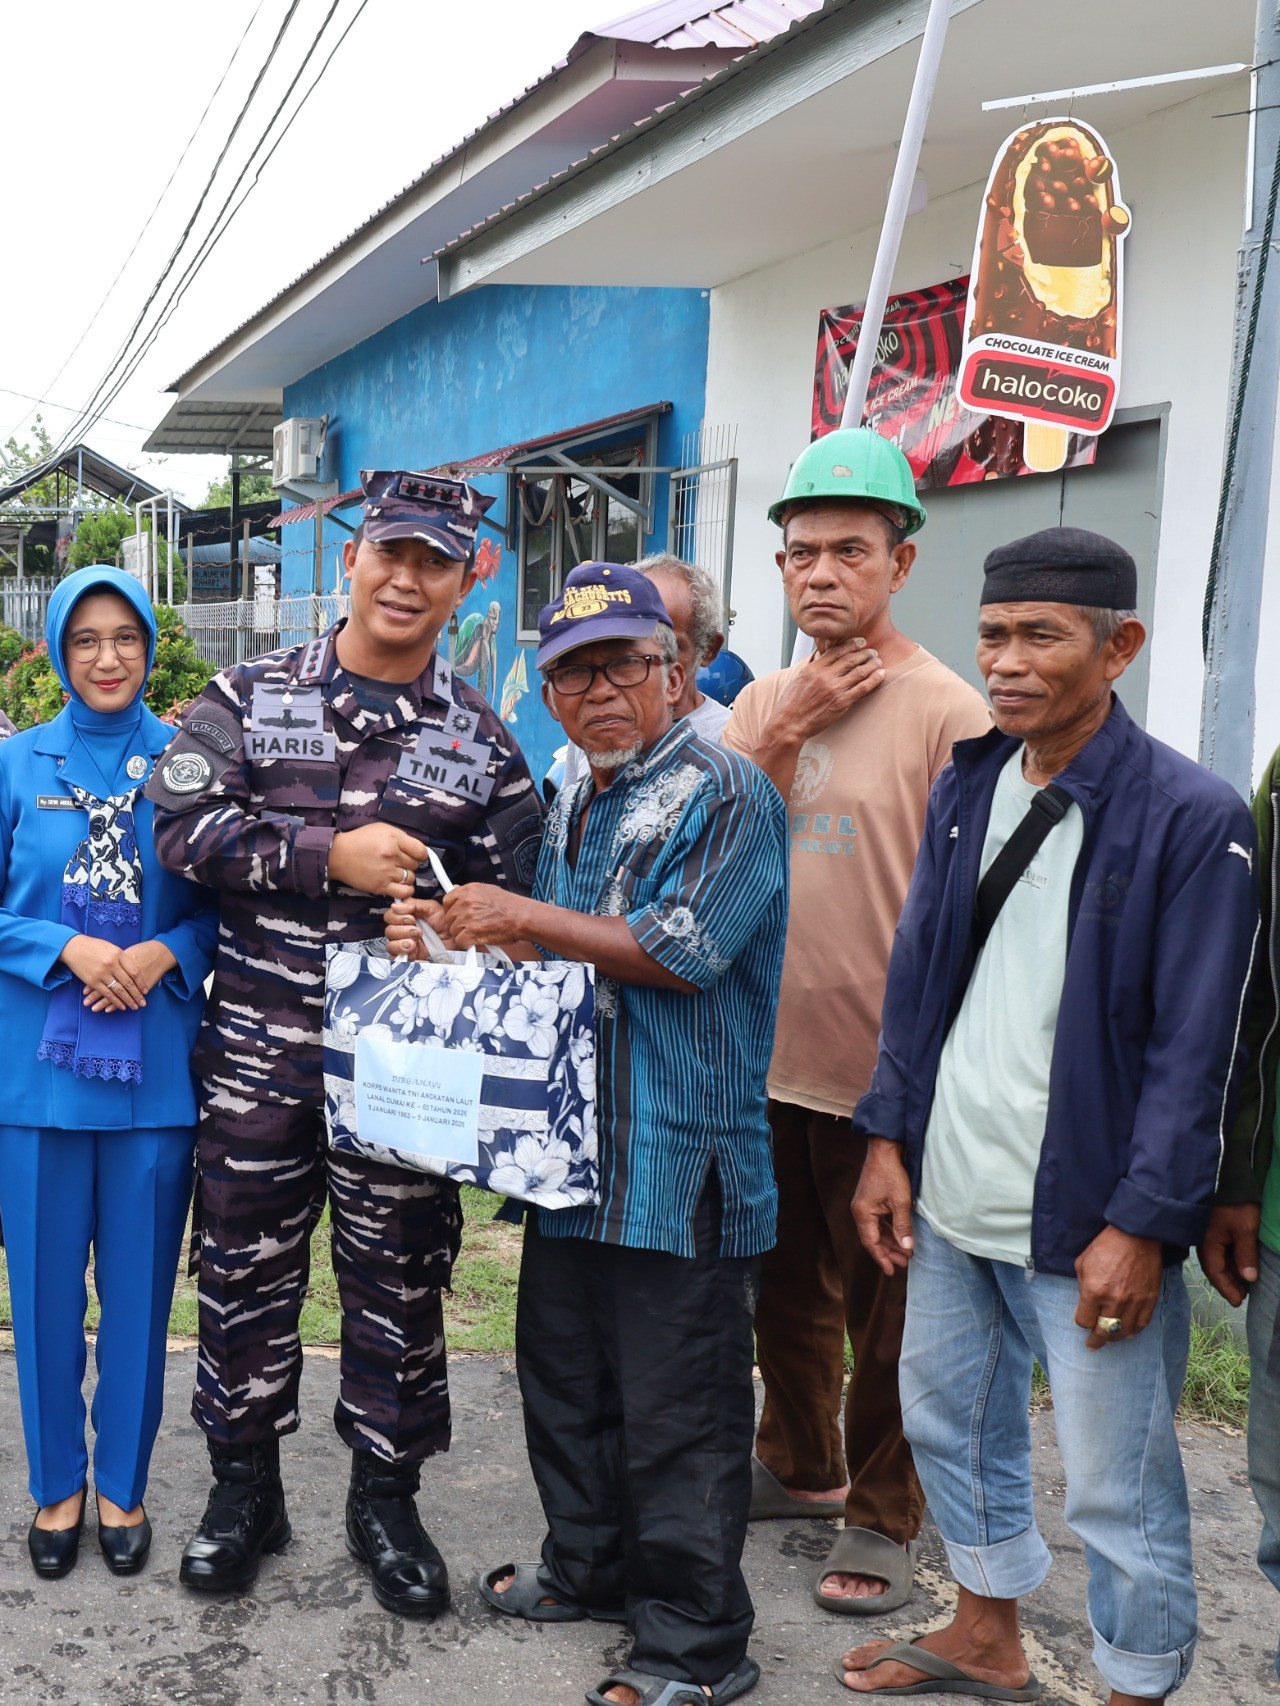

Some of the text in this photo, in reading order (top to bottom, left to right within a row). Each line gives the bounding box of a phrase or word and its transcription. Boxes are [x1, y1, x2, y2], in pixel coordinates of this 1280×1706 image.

[834, 331, 899, 394] haloko
[984, 337, 1110, 372] CHOCOLATE ICE CREAM
[870, 395, 885, 410] ICE
[887, 377, 918, 402] CREAM
[981, 368, 1101, 411] halocoko
[927, 392, 958, 434] NE
[252, 738, 324, 756] HARIS
[410, 760, 482, 797] TNI AL
[362, 1081, 474, 1106] KORPS WANITA TNI ANGKATAN LAUT
[367, 1093, 386, 1103] LANAL
[386, 1097, 405, 1107] DUMAI
[406, 1101, 416, 1109] KE
[430, 1105, 452, 1114] TAHUN
[372, 1105, 397, 1116] JANUARI
[398, 1111, 411, 1119] 1963
[422, 1115, 450, 1125] JANUARI
